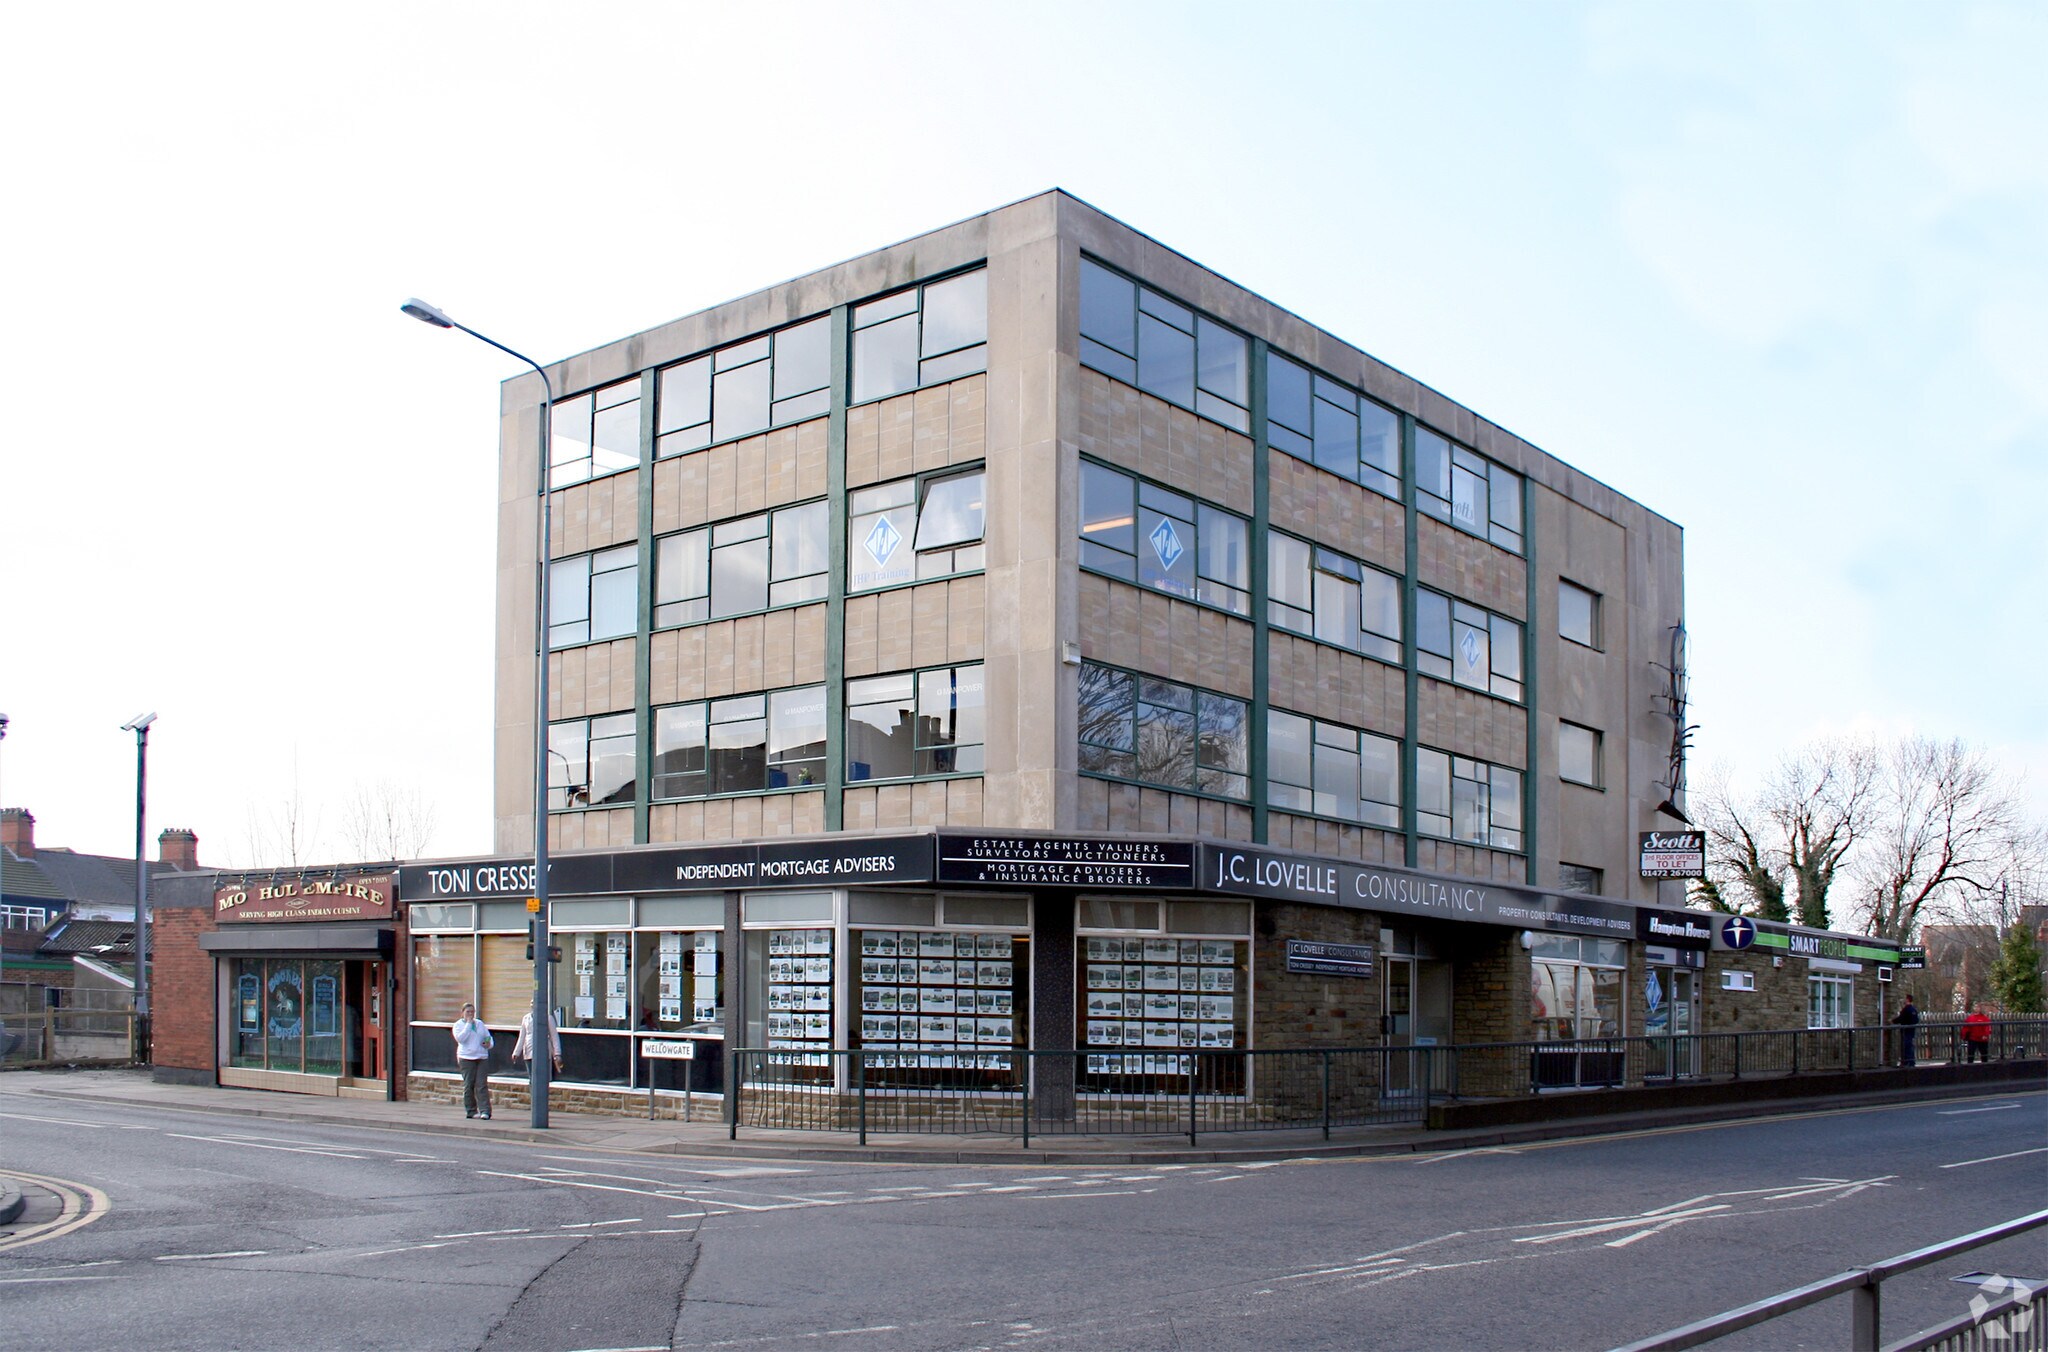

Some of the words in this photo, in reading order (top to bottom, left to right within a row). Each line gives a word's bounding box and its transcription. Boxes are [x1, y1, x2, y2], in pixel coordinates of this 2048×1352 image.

[973, 839, 1024, 849] ESTATE
[1034, 841, 1089, 850] AGENTS
[1099, 843, 1159, 853] VALUERS
[1644, 832, 1701, 849] Scotts
[967, 848, 1049, 859] SURVEYORS
[1065, 851, 1166, 862] AUCTIONEERS
[676, 862, 755, 880] INDEPENDENT
[761, 859, 830, 876] MORTGAGE
[834, 855, 895, 873] ADVISERS
[987, 864, 1064, 874] MORTGAGE
[1074, 866, 1142, 876] ADVISERS
[428, 869, 470, 894] TONI
[476, 864, 552, 892] CRESSE
[978, 872, 986, 881] &
[995, 873, 1079, 883] INSURANCE
[1088, 875, 1151, 885] BROKERS
[1216, 853, 1250, 888] J.C.
[1256, 858, 1336, 895] LOVELLE
[1355, 873, 1486, 912] CONSULTANCY
[303, 882, 385, 906] EMPIRE
[239, 911, 266, 919] SERVING
[267, 910, 283, 918] HIGH
[285, 909, 307, 917] CLASS
[307, 908, 331, 916] INDIAN
[333, 907, 362, 915] CUISINE
[1498, 906, 1529, 919] PROPERTY
[1570, 914, 1606, 927] DEVELOPMENT
[1607, 919, 1631, 931] ADVISERS
[1650, 917, 1685, 937] Hampton
[1685, 921, 1711, 939] House
[1300, 944, 1325, 955] LOVELLE
[1328, 947, 1371, 959] CONSULTANCY
[644, 1044, 691, 1055] WELLOWGATE
